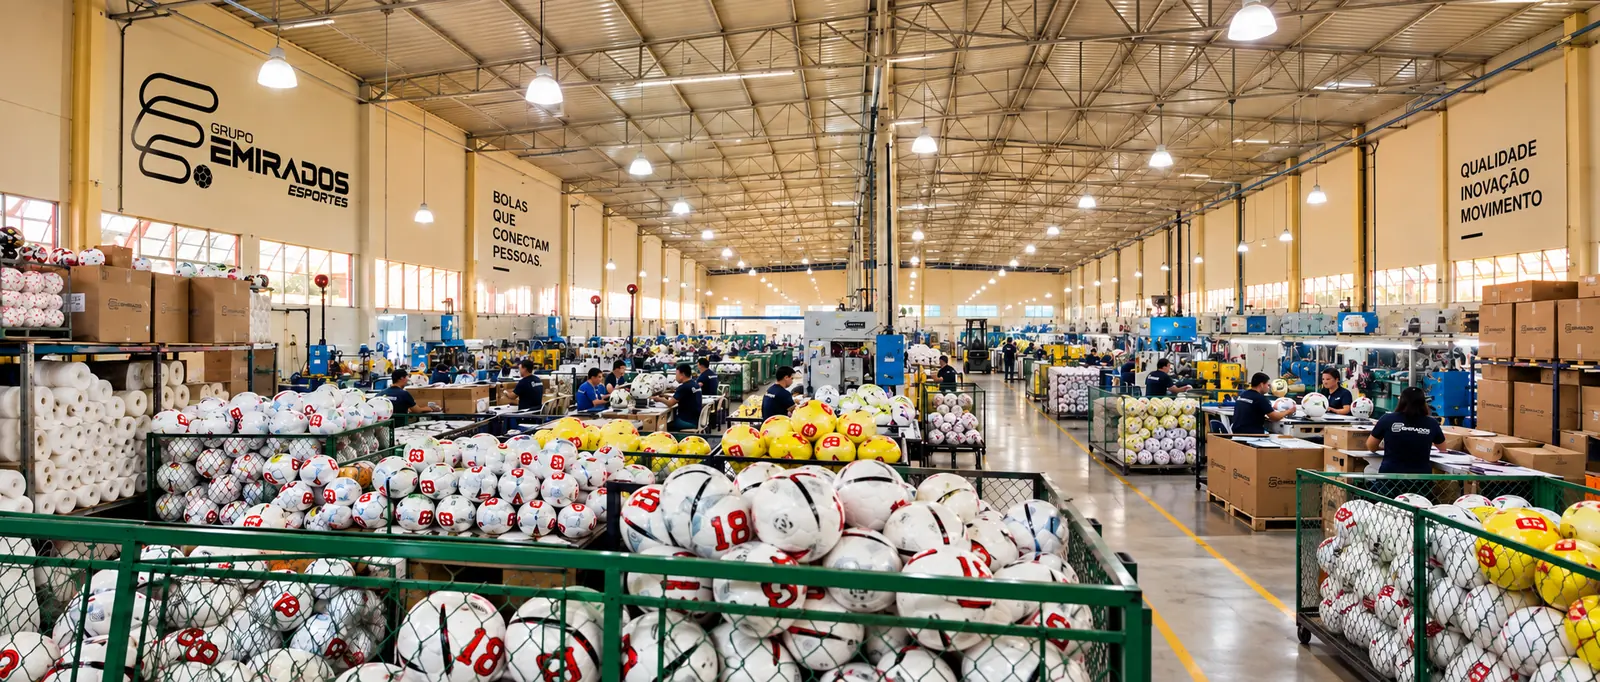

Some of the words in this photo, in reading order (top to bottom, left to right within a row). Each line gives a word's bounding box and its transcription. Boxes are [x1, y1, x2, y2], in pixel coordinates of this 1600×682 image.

[210, 122, 254, 144] GRUPO
[210, 135, 350, 196] EMIRADOS
[1461, 139, 1537, 178] QUALIDADE
[288, 185, 349, 209] ESPORTES
[1461, 167, 1530, 201] INOVAÇÃO
[493, 190, 528, 213] BOLAS
[1461, 189, 1543, 223] MOVIMENTO
[493, 209, 516, 227] QUE
[493, 226, 550, 252] CONECTAM
[493, 245, 542, 267] PESSOAS.
[710, 509, 751, 552] 18
[456, 627, 505, 677] 18
